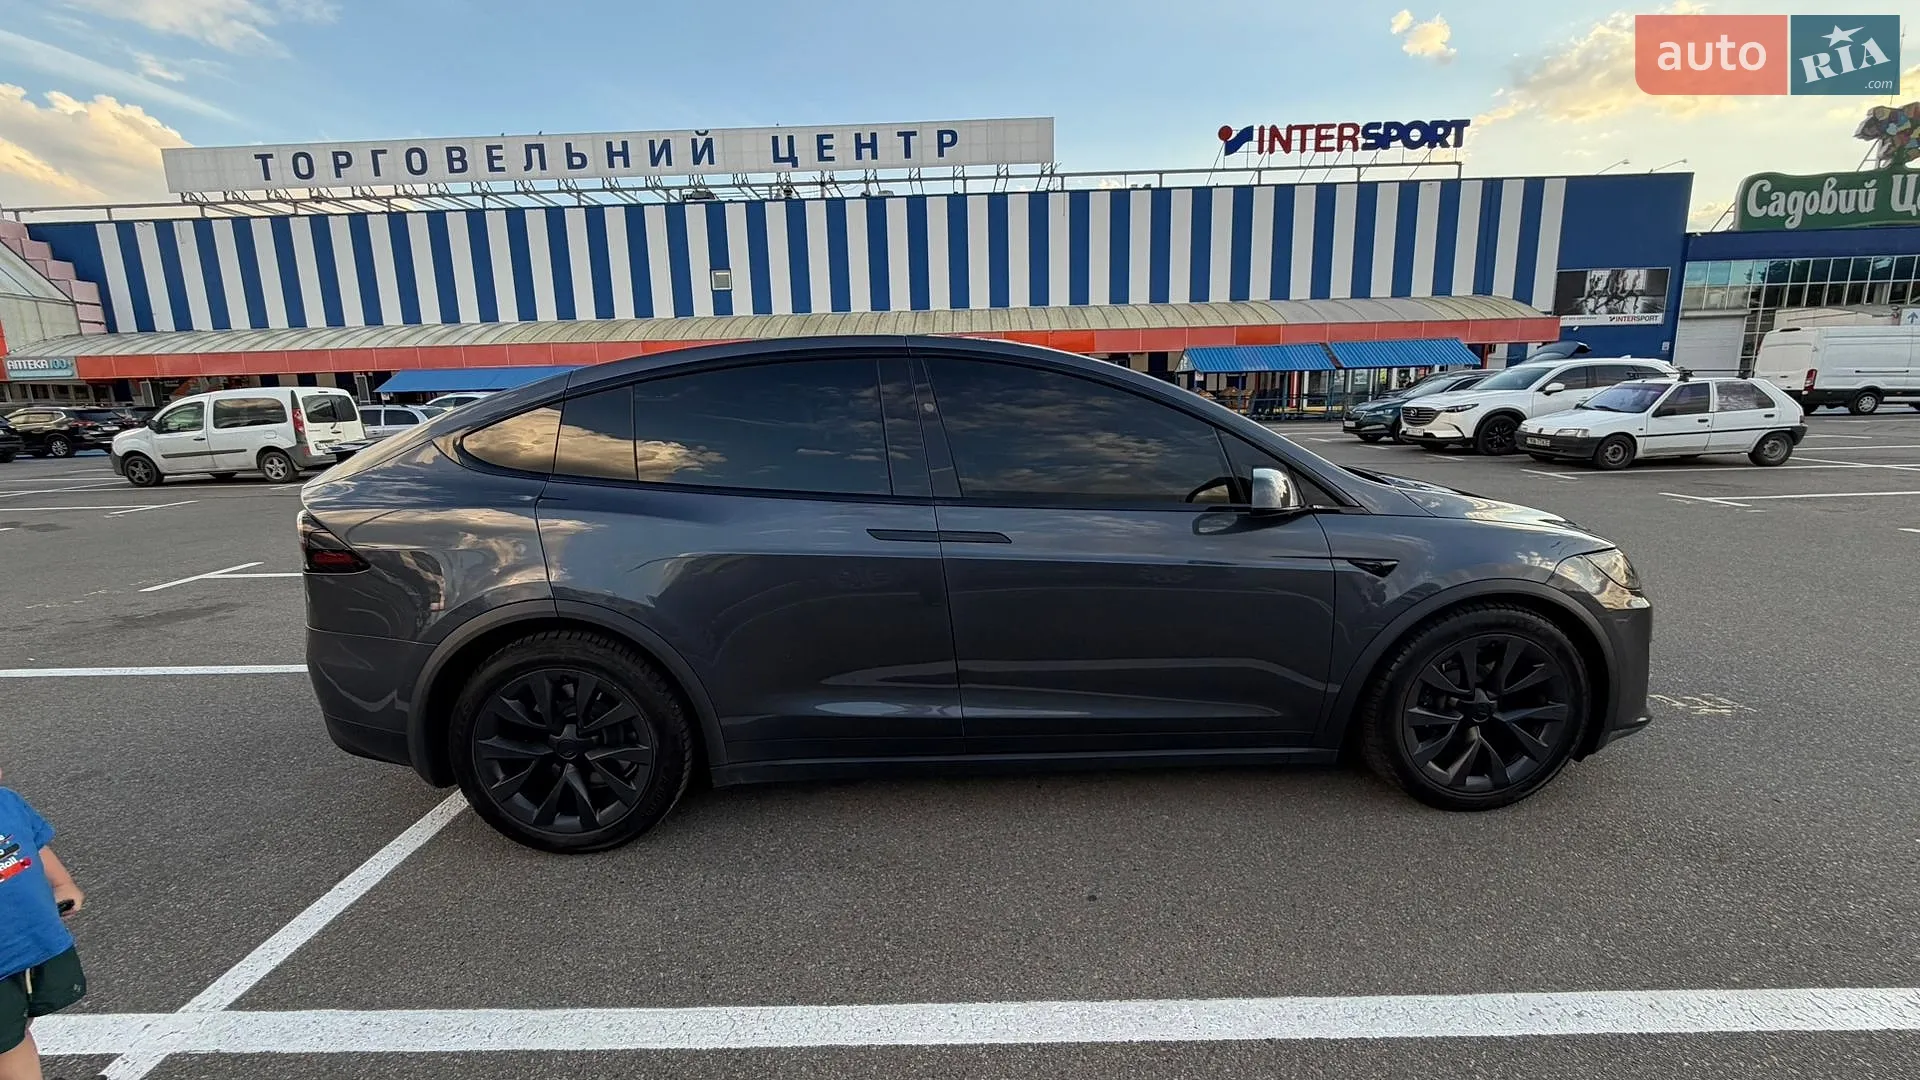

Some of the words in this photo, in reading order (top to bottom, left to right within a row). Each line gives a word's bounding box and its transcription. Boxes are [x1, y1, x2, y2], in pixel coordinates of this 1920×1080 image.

[254, 129, 716, 181] ТОРГОВЕЛЬНИЙ
[771, 129, 959, 169] ЦЕНТР
[1257, 119, 1471, 154] INTERSPORT
[1747, 177, 1878, 229] Садовий
[1891, 174, 1920, 216] Ц
[6, 359, 49, 370] АПТЕКА
